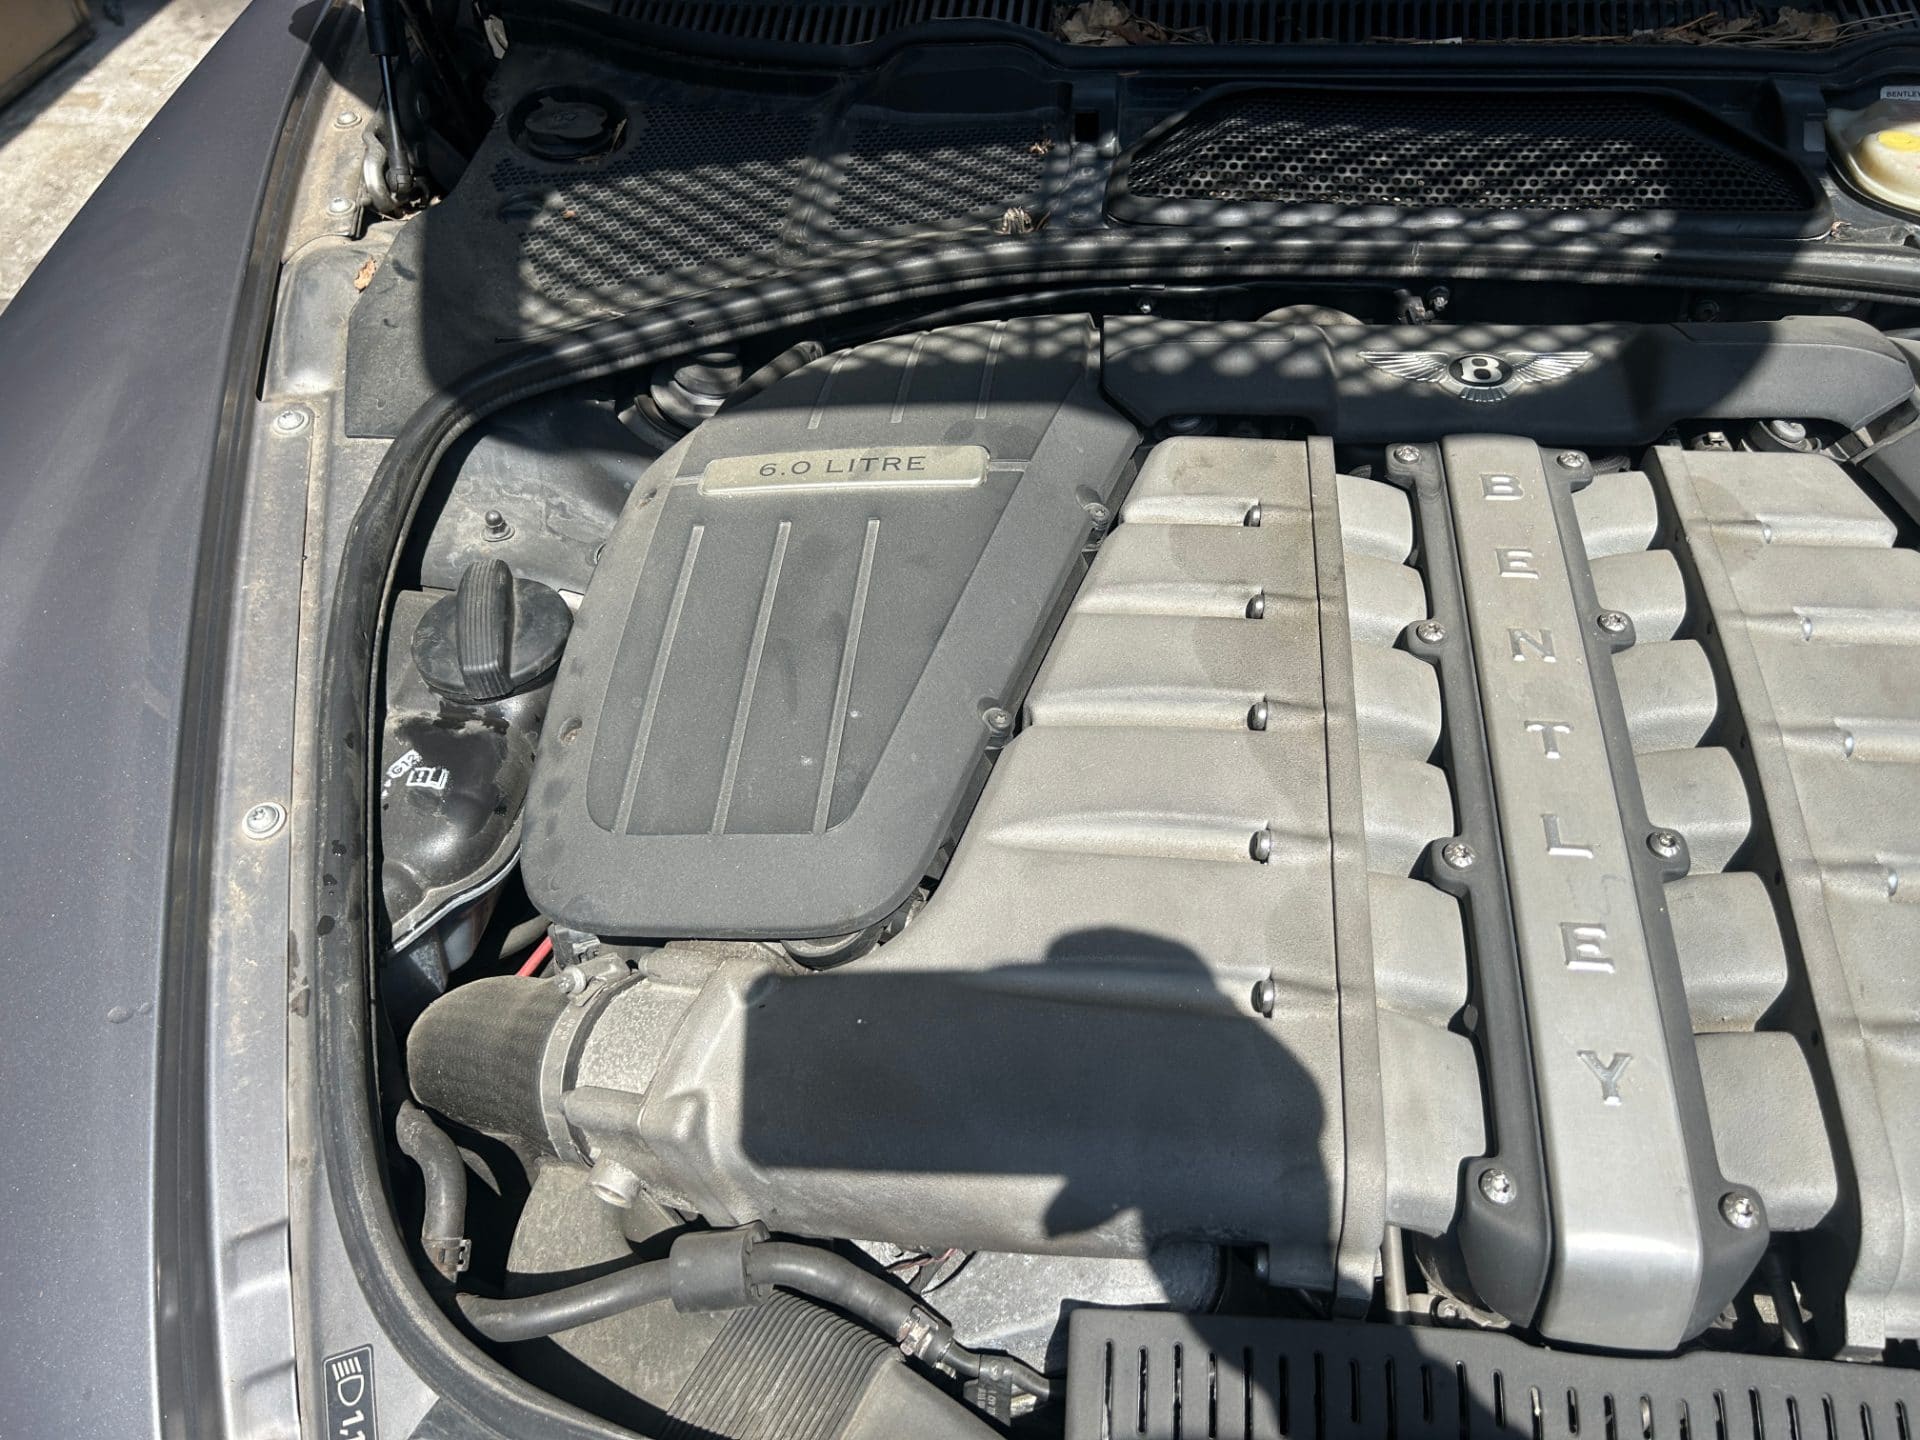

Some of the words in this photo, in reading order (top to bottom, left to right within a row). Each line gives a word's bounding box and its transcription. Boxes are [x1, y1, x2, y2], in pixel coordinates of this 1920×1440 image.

[759, 461, 811, 477] 6.0
[825, 455, 926, 474] LITRE
[1480, 472, 1632, 1106] BENTLEY
